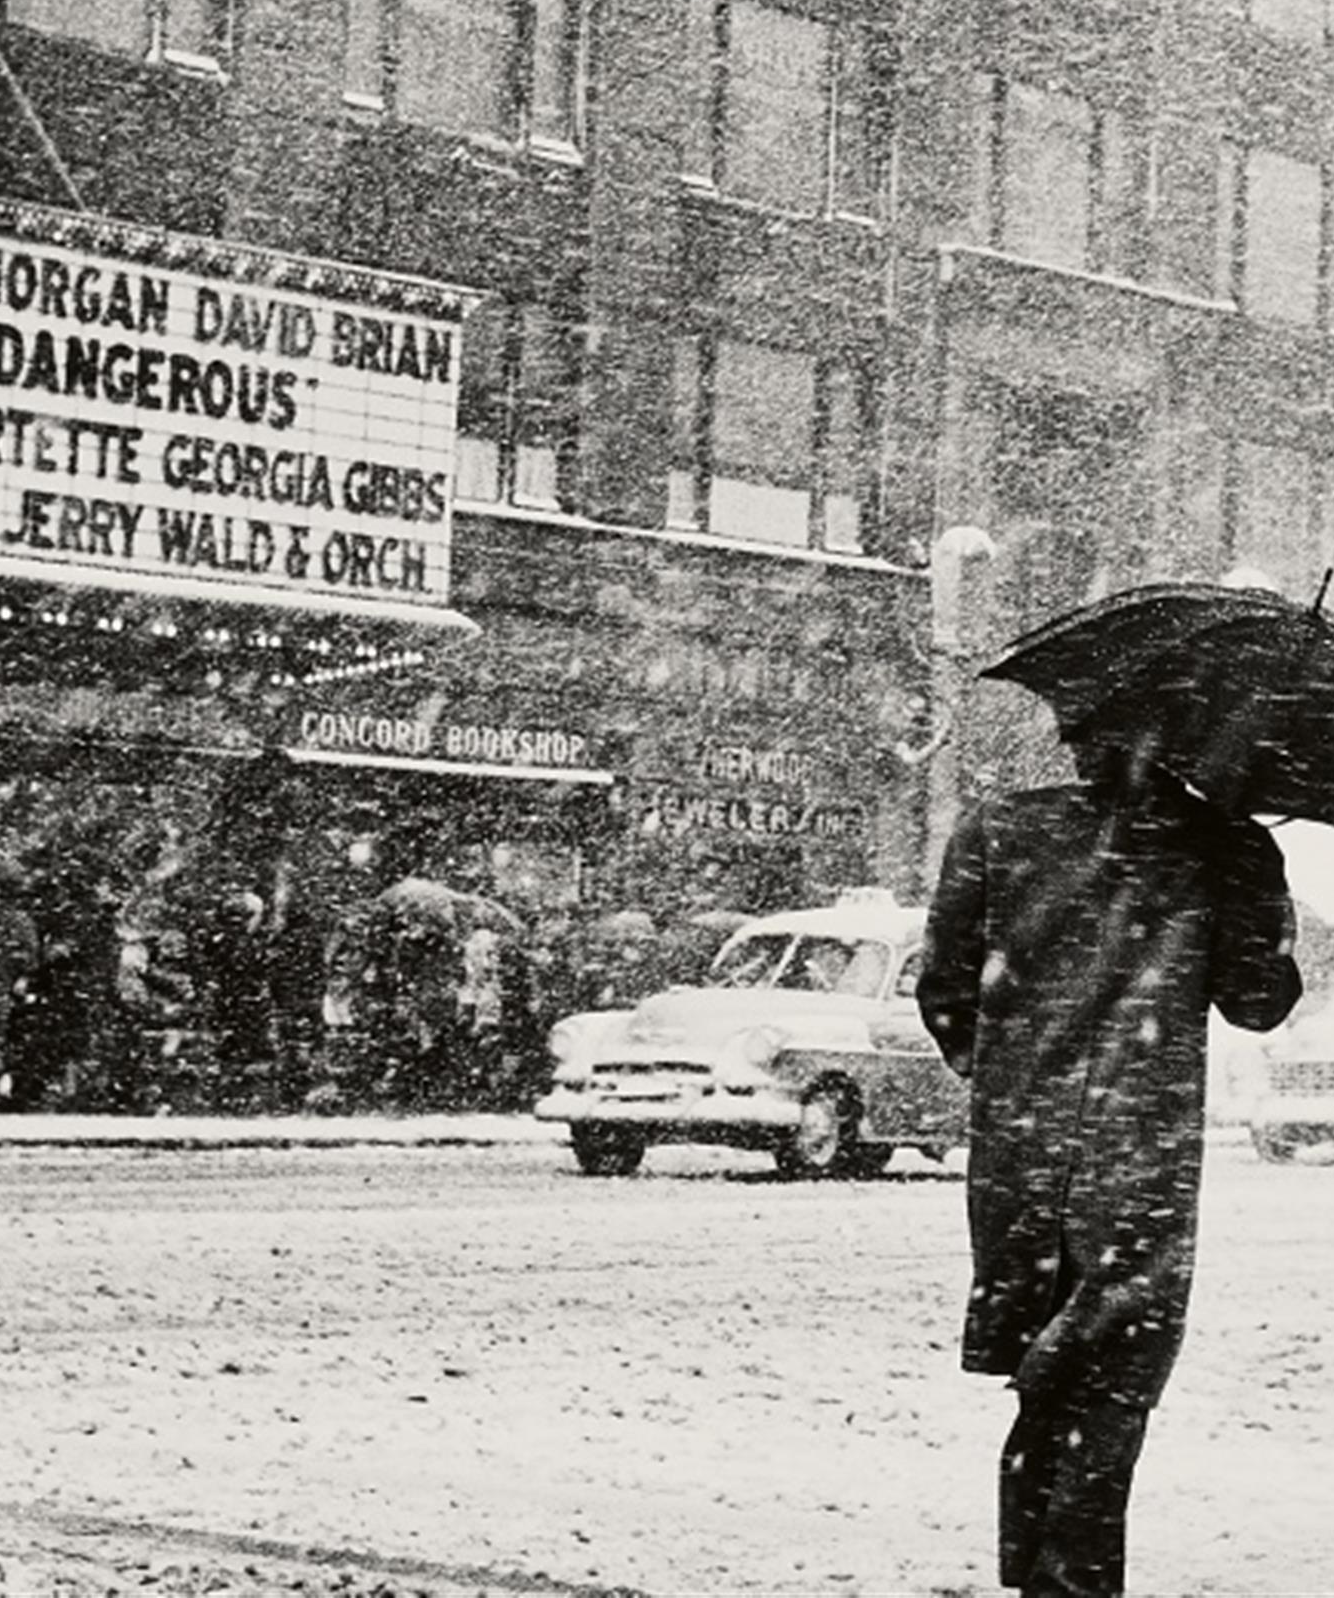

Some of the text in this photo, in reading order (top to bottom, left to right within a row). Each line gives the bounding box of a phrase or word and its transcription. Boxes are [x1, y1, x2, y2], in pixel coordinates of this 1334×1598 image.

[194, 288, 316, 357] DAVID
[332, 312, 453, 384] BRIAN
[163, 434, 335, 511] GEORGIA
[342, 461, 447, 524] GIBBS
[2, 489, 145, 559] JERRY
[157, 507, 272, 573] WALD
[284, 525, 311, 578] &
[322, 531, 433, 595] ORCH.
[301, 712, 585, 764] CONCORD BOOKSHOP
